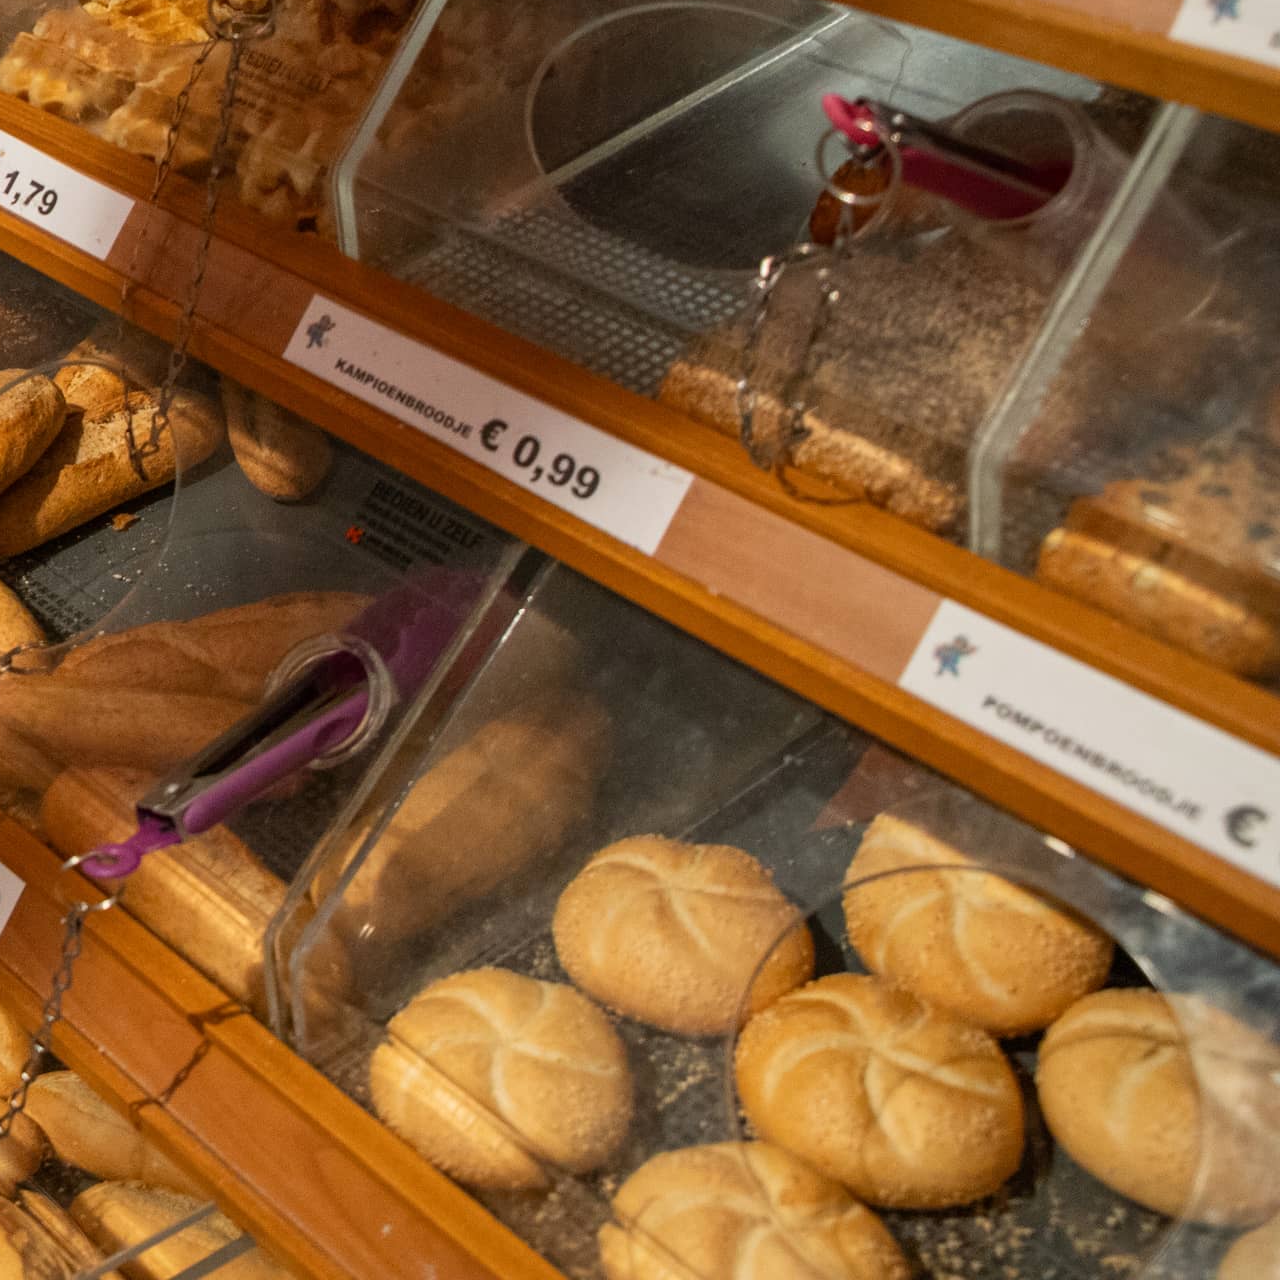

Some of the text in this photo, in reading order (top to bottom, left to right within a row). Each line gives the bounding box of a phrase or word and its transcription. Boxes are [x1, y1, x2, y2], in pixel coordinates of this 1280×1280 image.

[2, 170, 59, 216] 1,79
[334, 358, 601, 500] KAMPIOENBROODJE € 0,99
[981, 694, 1268, 849] POMPOENBROODJE €
